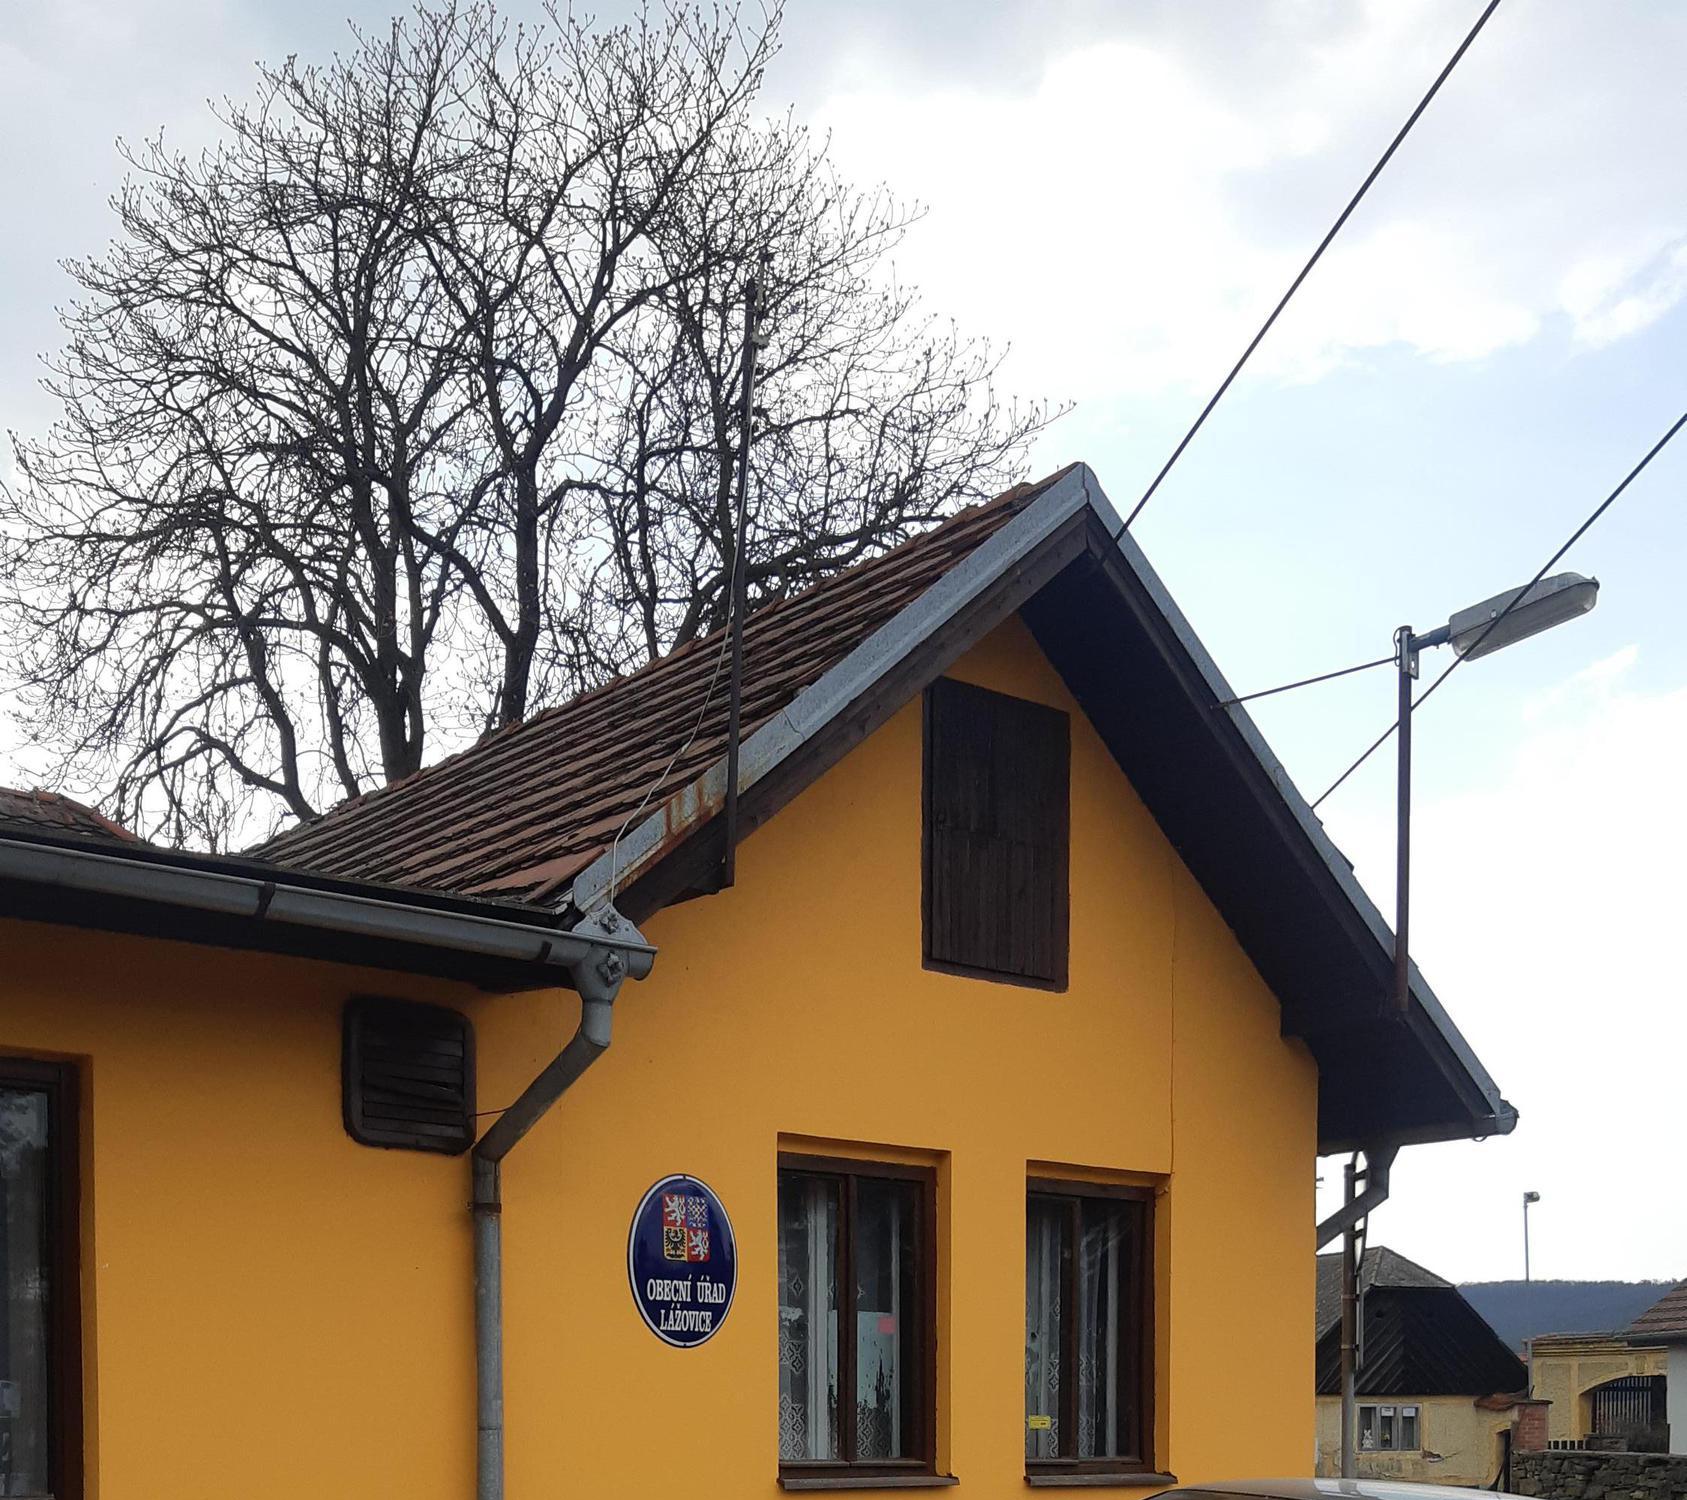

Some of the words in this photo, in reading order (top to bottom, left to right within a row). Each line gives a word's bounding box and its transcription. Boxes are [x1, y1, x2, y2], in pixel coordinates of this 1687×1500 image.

[646, 1273, 692, 1302] OBECNÍ
[696, 1274, 727, 1304] ÚŘAD
[660, 1302, 713, 1333] LÁŽOVICE
